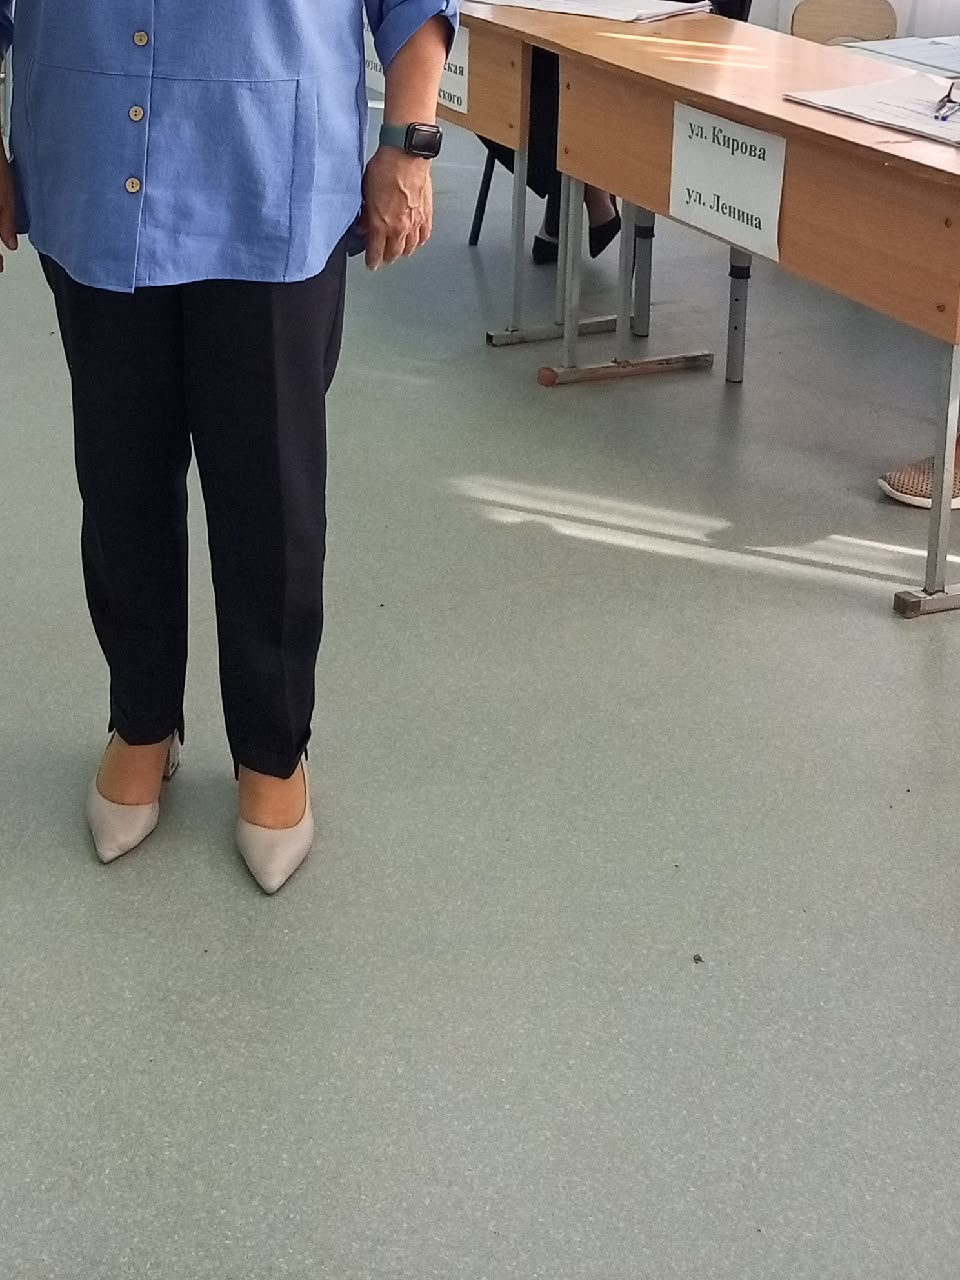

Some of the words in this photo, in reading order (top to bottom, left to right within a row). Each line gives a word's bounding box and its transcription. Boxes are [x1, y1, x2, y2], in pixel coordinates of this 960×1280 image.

[688, 122, 707, 140] ул.
[711, 125, 767, 162] Кирова
[685, 187, 706, 207] ул.
[709, 193, 762, 231] Ленина
